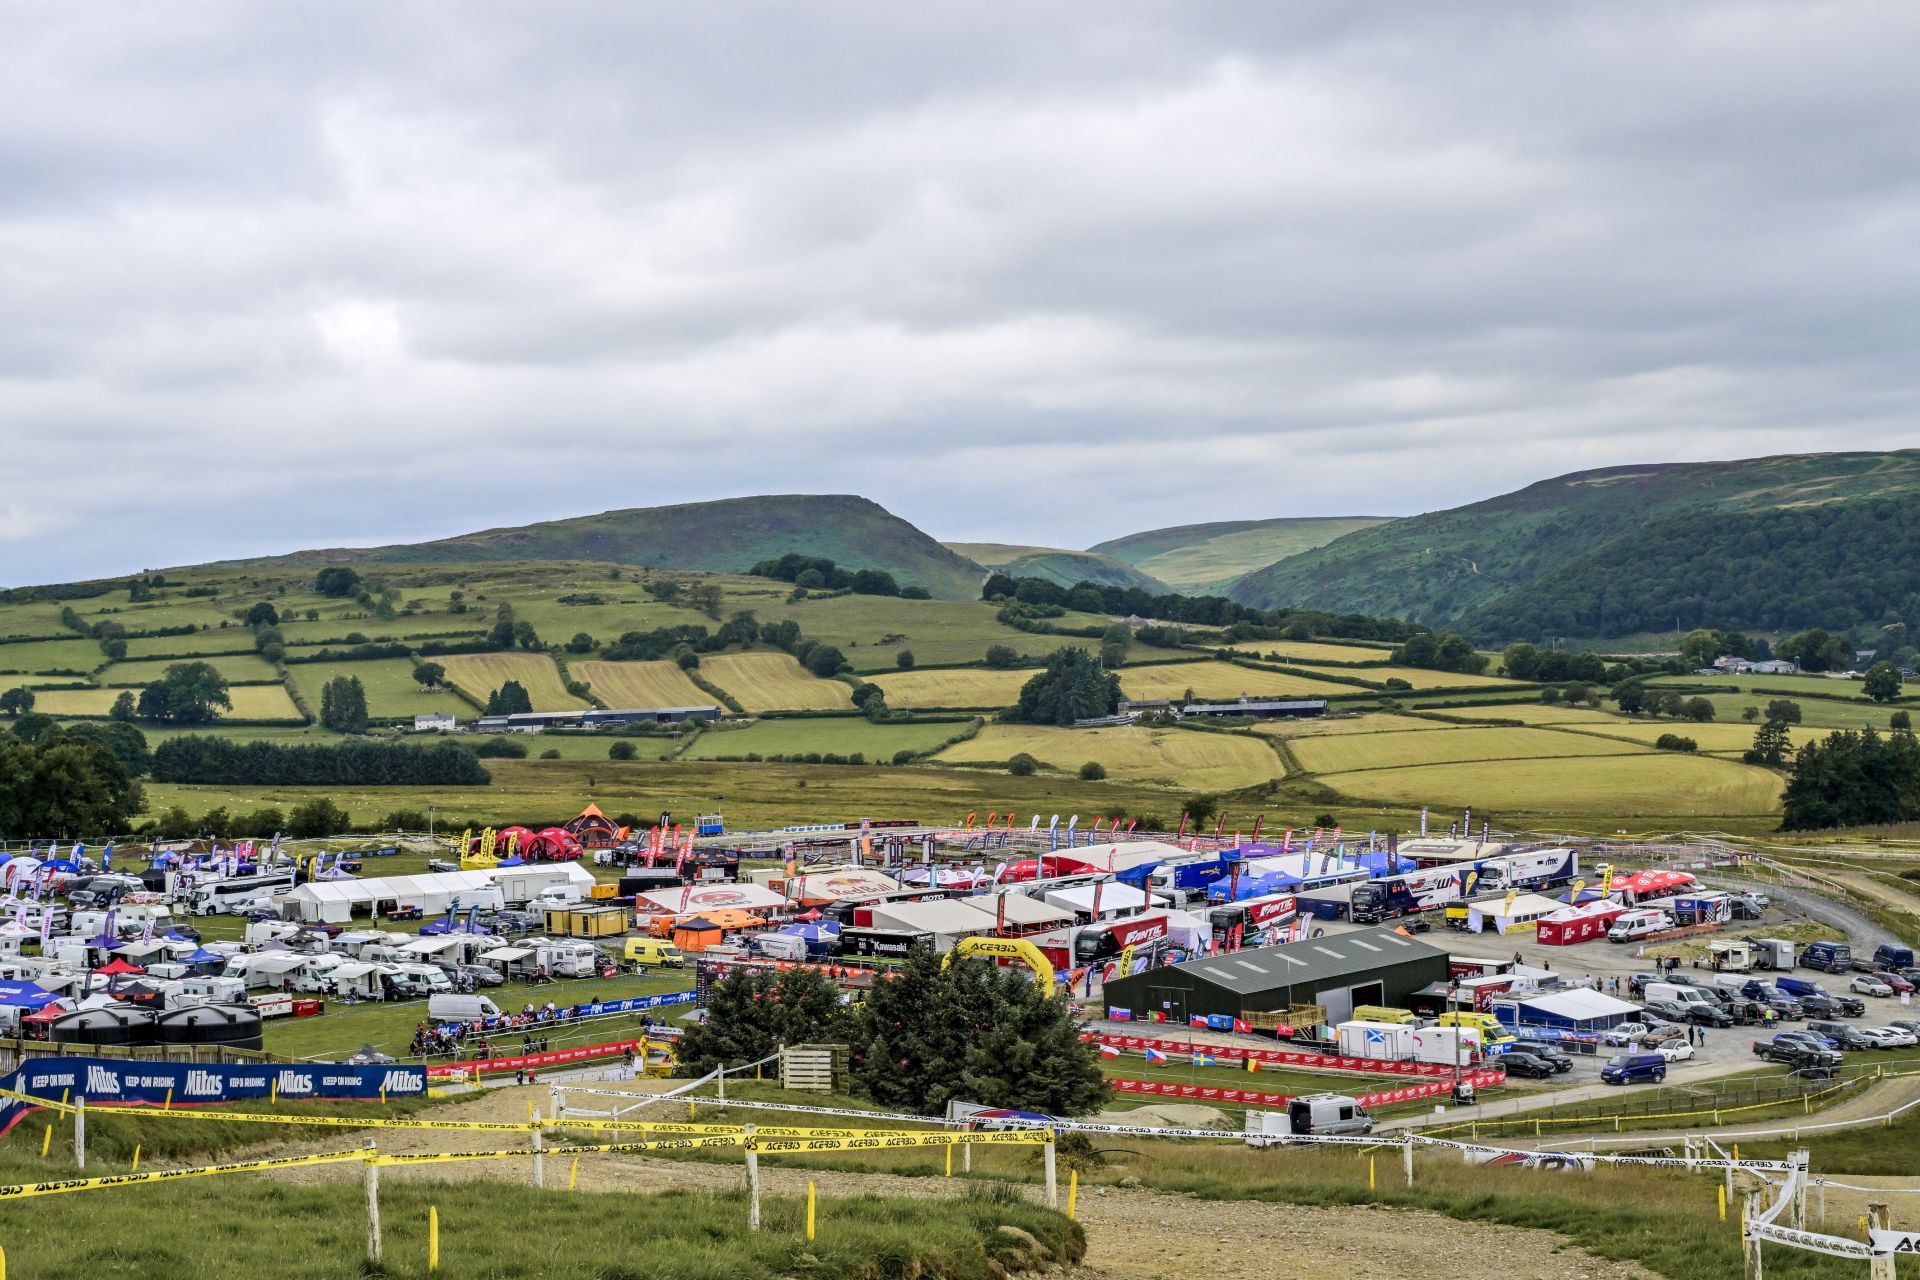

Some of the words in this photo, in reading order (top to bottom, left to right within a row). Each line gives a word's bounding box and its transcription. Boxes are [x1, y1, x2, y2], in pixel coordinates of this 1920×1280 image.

[657, 829, 667, 854] MAXXIS
[686, 833, 695, 858] MAXXIS
[647, 845, 657, 868] MAXXIS
[828, 887, 861, 897] Red
[860, 883, 894, 894] Bull
[920, 894, 944, 902] MOTO
[1259, 898, 1293, 917] FANTIC
[1124, 925, 1163, 945] FANTIC
[874, 941, 907, 952] Kawasaki
[970, 942, 1018, 953] ACERBIS
[620, 999, 634, 1011] FIM
[649, 995, 662, 1006] FIM
[590, 1003, 603, 1015] FIM
[1490, 1044, 1504, 1056] FIM
[32, 1075, 50, 1089] KEEP
[50, 1075, 58, 1087] ON
[58, 1074, 75, 1086] RIDING
[86, 1065, 120, 1094] Mitas
[141, 1076, 152, 1088] ON
[152, 1076, 175, 1088] RIDING
[184, 1070, 223, 1096] Mitas
[230, 1077, 240, 1088] KEEP
[244, 1077, 266, 1088] RIDING
[276, 1070, 313, 1094] Mitas
[322, 1076, 337, 1086] KEEP
[338, 1077, 345, 1086] ON
[379, 1070, 423, 1092] Mitas
[655, 1140, 694, 1149] ACERBIS
[700, 1137, 736, 1147] ACERBIS
[765, 1141, 800, 1150] ACERBIS
[806, 1140, 841, 1149] ACERBIS
[847, 1138, 880, 1148] ACERBIS
[886, 1136, 917, 1146] ACERBIS
[922, 1136, 952, 1144] ACERBIS
[958, 1134, 986, 1143] ACERBIS
[992, 1133, 1019, 1142] ACERBIS
[1738, 1160, 1773, 1168] ACERBIS
